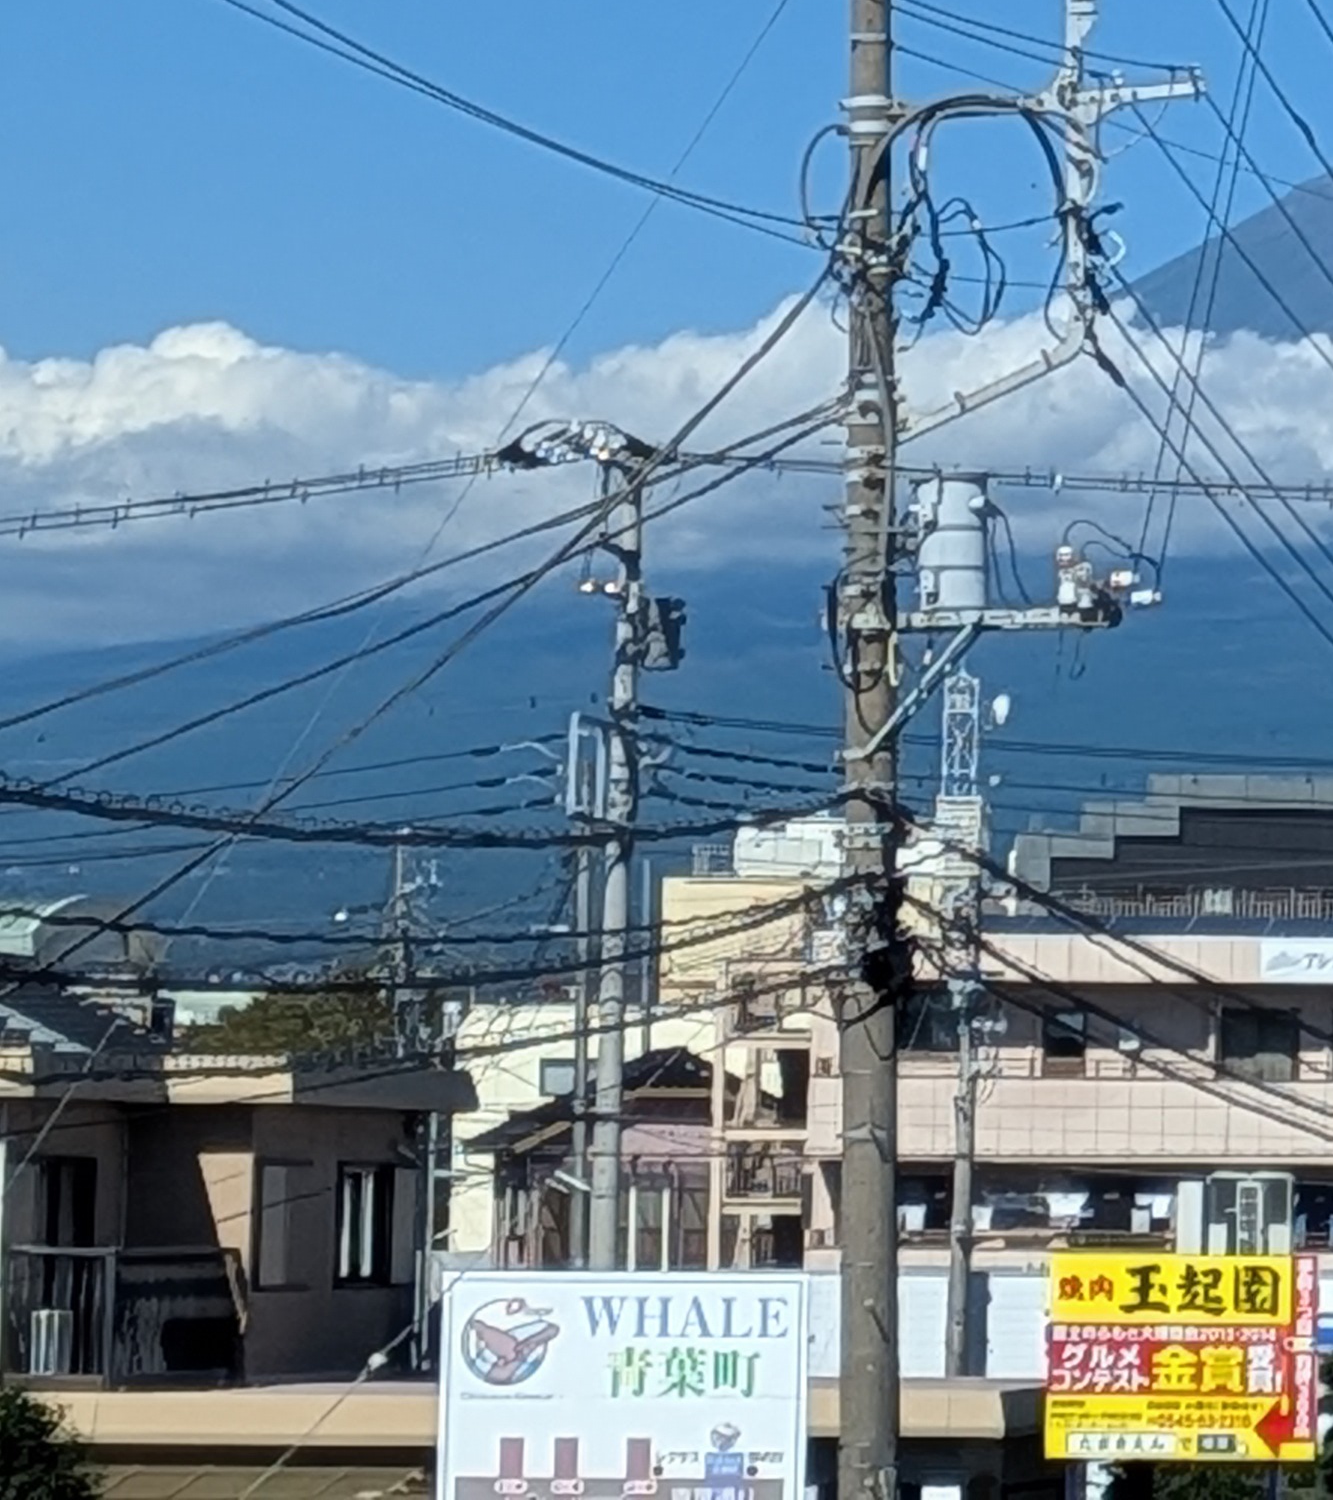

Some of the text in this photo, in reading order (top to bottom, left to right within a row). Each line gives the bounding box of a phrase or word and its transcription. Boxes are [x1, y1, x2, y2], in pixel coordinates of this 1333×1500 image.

[1057, 1274, 1115, 1302] 焼肉
[581, 1295, 789, 1338] WHALE
[605, 1345, 761, 1399] 青葉町
[1061, 1344, 1141, 1369] グルメ
[1151, 1344, 1245, 1393] 金賞
[1050, 1369, 1149, 1393] コンテスト
